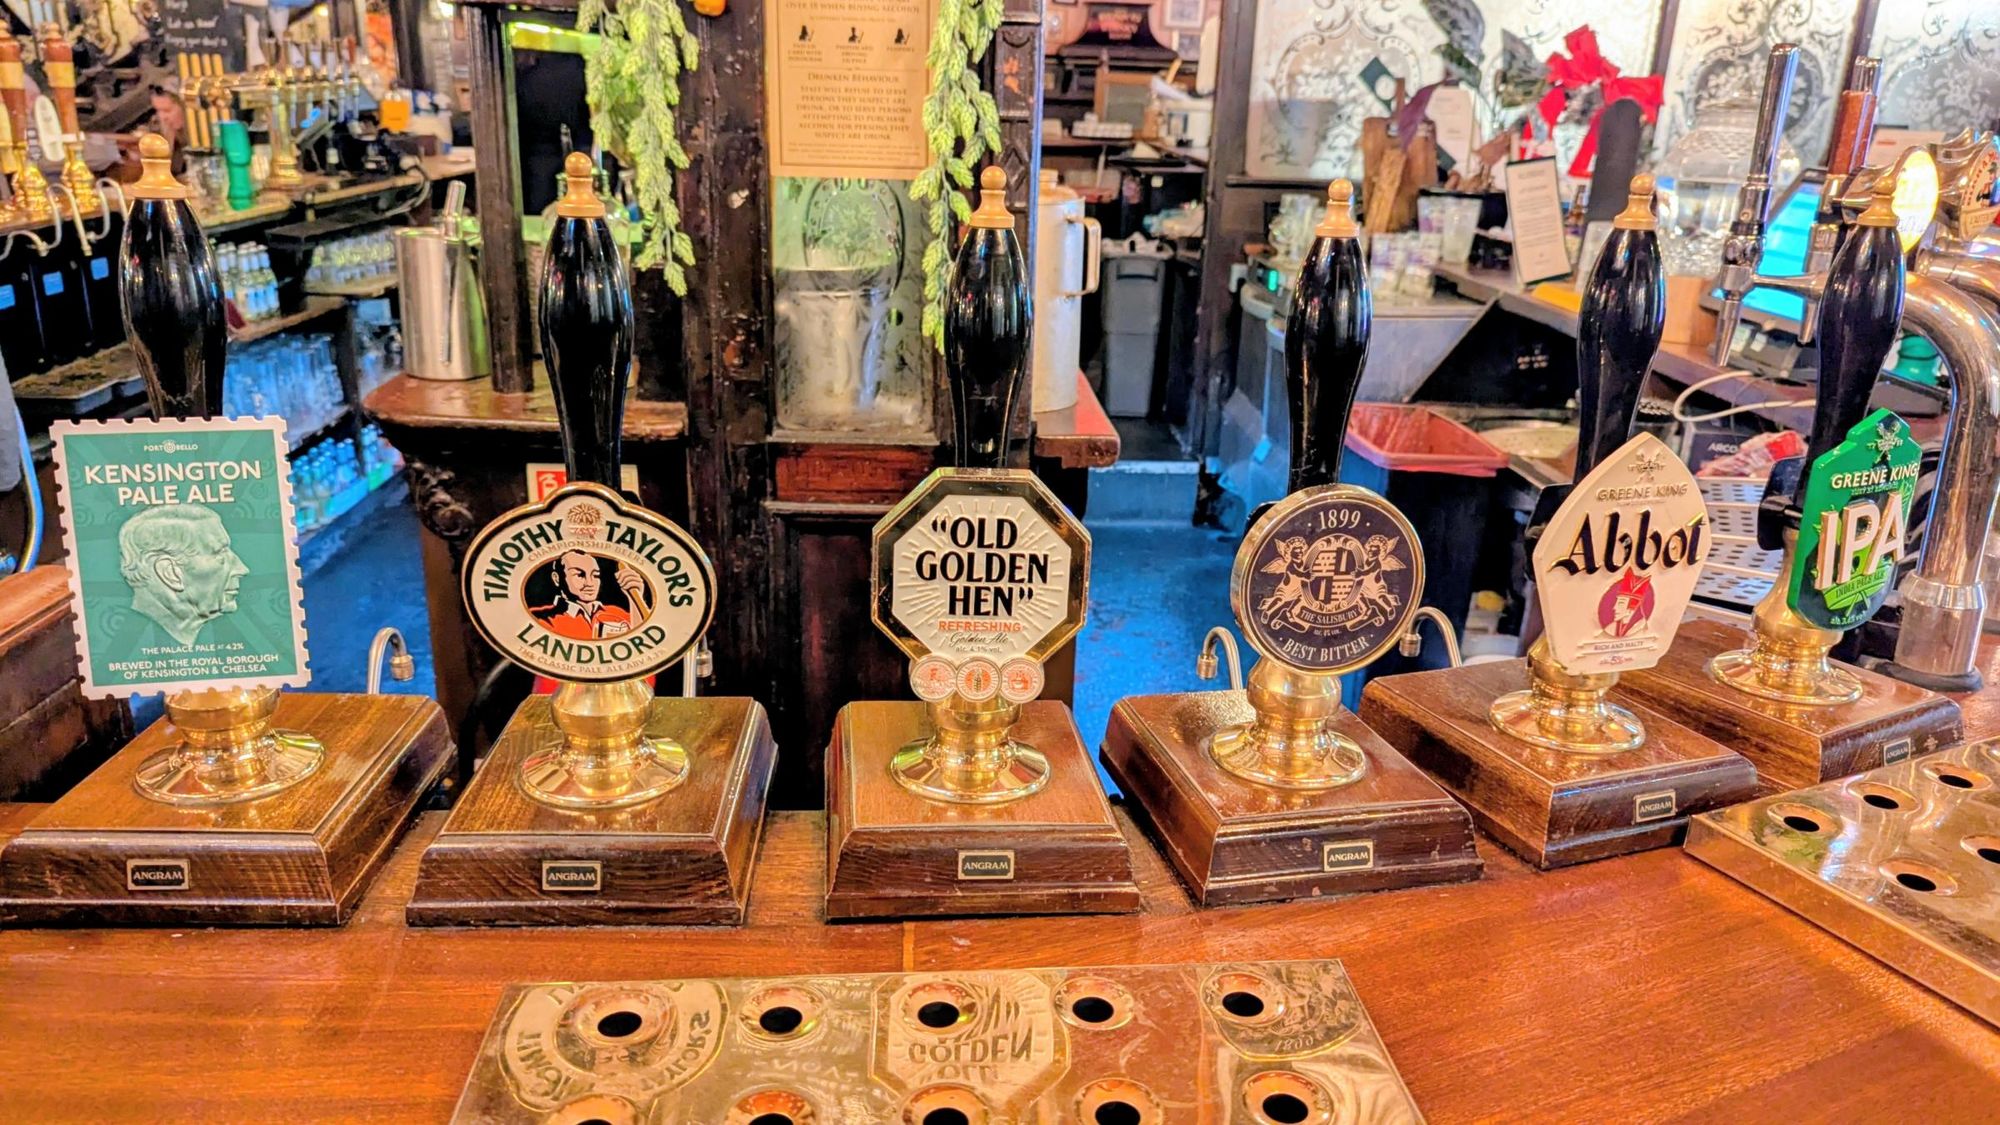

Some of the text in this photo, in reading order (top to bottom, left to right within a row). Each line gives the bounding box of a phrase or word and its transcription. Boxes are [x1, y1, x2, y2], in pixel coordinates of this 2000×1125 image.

[808, 72, 899, 83] DRUNKEN BEHAVIOUR
[84, 460, 262, 485] KENSINGTON
[1831, 468, 1888, 489] GREENE
[1889, 462, 1918, 482] KING
[118, 483, 235, 506] PALE ALE
[1596, 483, 1689, 501] GREENE KING
[1319, 508, 1361, 529] 1899
[1548, 509, 1706, 576] Abbot
[1814, 491, 1905, 590] IPA
[528, 540, 645, 566] CHAMPIONSHIP BEERS
[483, 519, 698, 608] TIMOTHY TAYLOR'S
[915, 550, 1049, 584] GOLDEN
[1835, 582, 1857, 598] INDIA
[1300, 608, 1358, 624] THE SALISBURY
[938, 620, 1022, 632] REFRESHING
[516, 623, 666, 665] LANDLORD
[949, 631, 1009, 647] Golden Ale
[141, 647, 160, 656] THE
[161, 645, 194, 654] PALACE
[195, 643, 216, 653] PALE
[1282, 636, 1370, 662] BEST BITTER
[109, 653, 279, 672] BREWED IN THE ROYAL BOROUGH
[124, 663, 267, 680] OF KENSINGTON & CHELSEA
[537, 655, 577, 673] CLASSIC
[579, 665, 602, 674] PALE
[606, 664, 624, 673] ALE
[626, 658, 644, 669] ABV
[1886, 746, 1908, 759] ANGRAM
[1639, 800, 1672, 813] ANGRAM
[963, 861, 1009, 870] ANGRAM
[1328, 851, 1369, 862] ANGRAM
[133, 871, 184, 880] ANGRAM
[548, 872, 596, 880] ANGRAM
